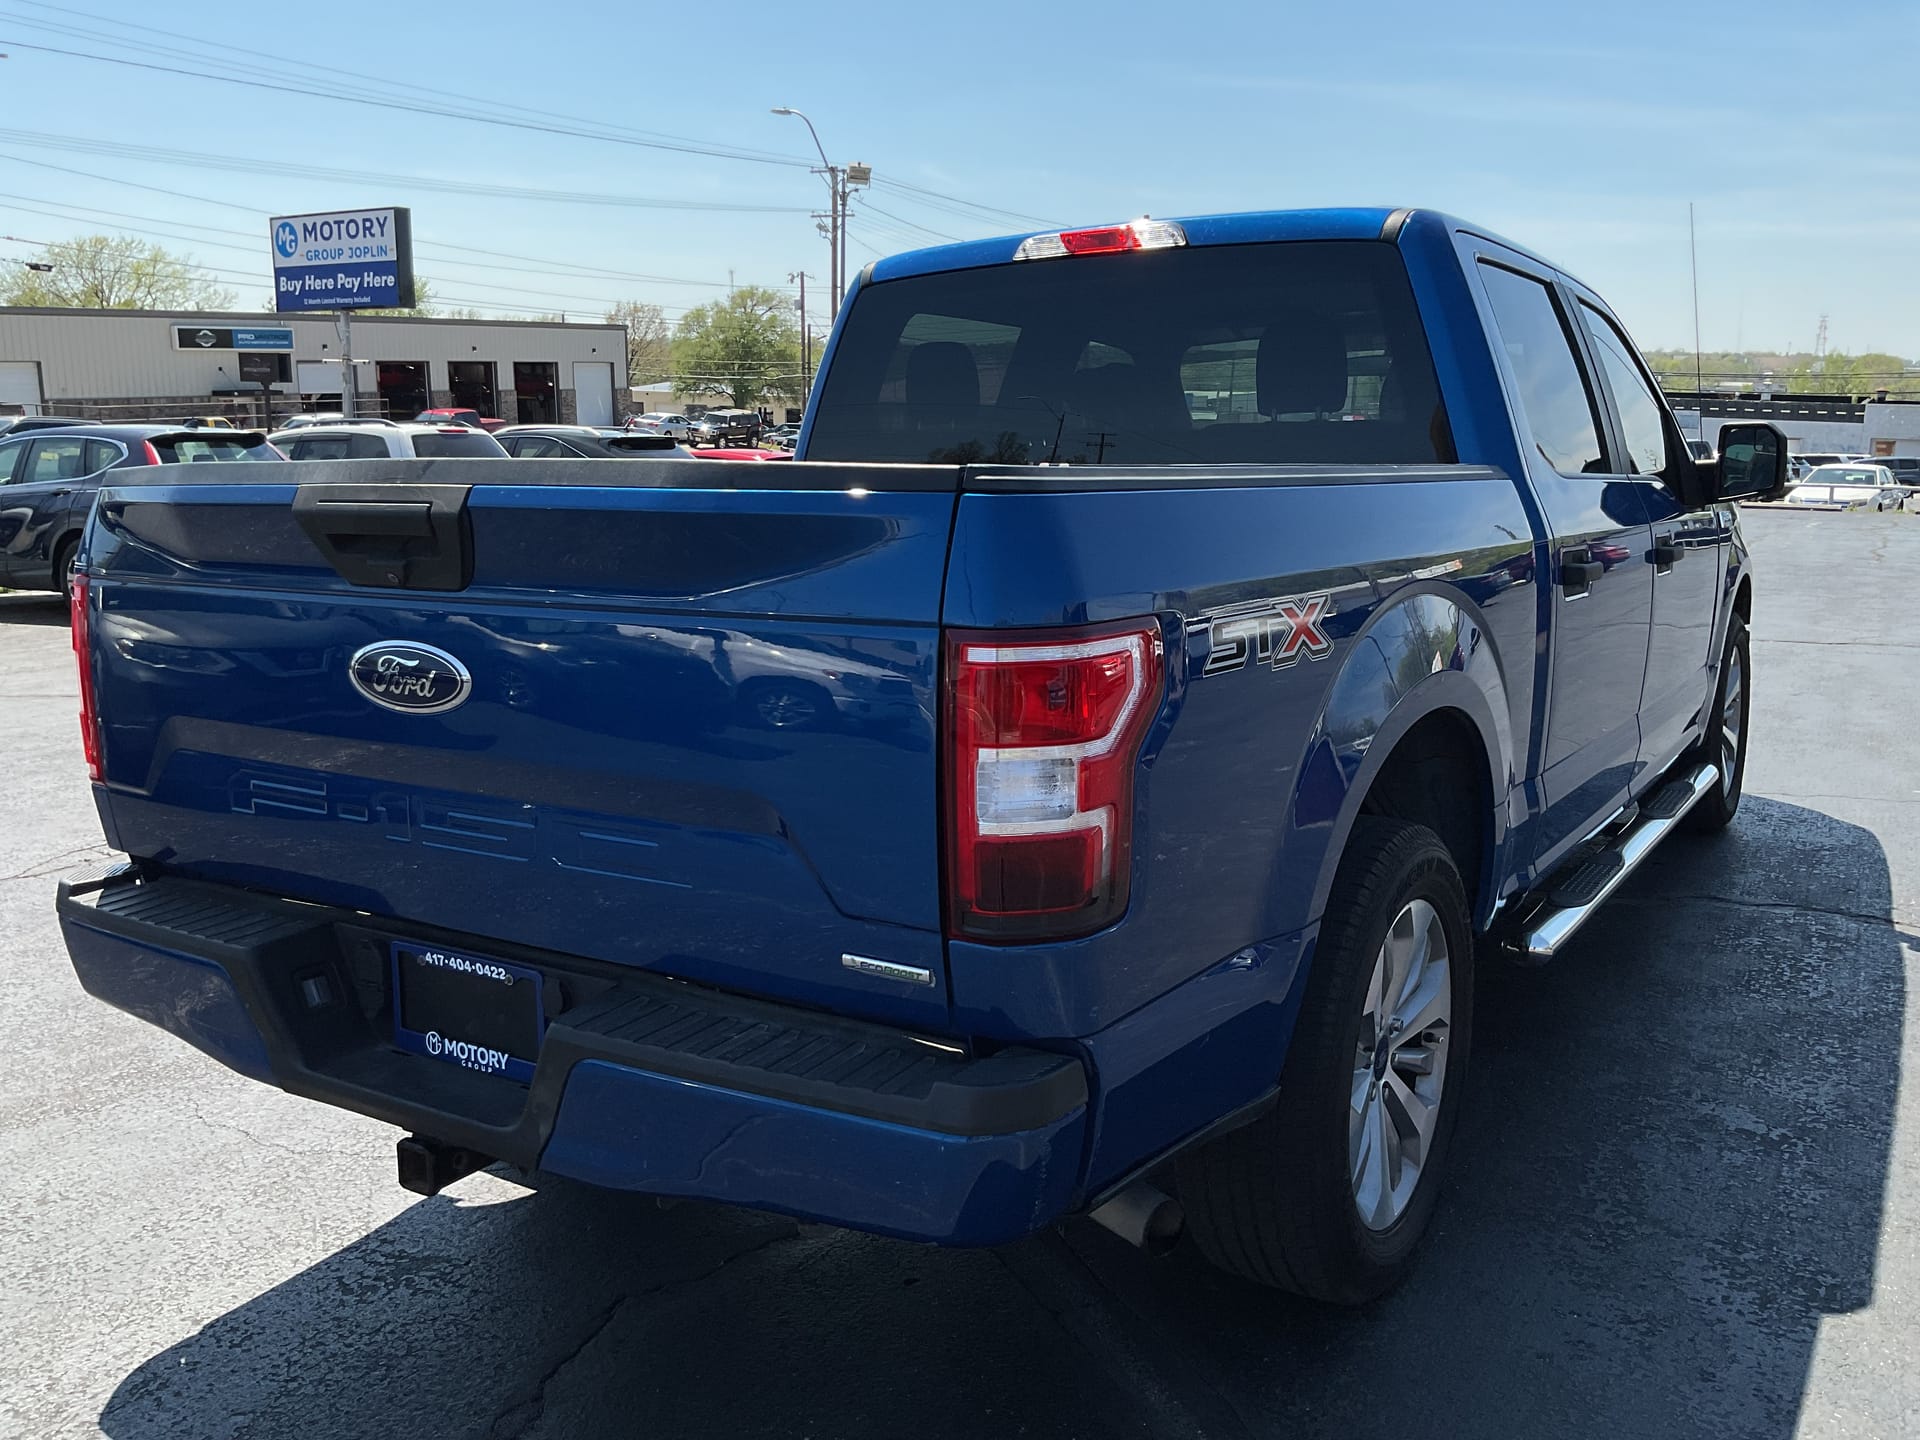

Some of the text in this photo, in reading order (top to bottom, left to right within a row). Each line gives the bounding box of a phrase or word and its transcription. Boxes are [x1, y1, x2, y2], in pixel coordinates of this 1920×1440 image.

[302, 216, 388, 243] MOTORY
[305, 244, 388, 261] GROUP JOPLIN
[279, 271, 395, 295] Buy Here Pay Here
[1203, 590, 1334, 678] STX
[373, 655, 436, 697] Ford
[444, 1038, 509, 1070] MOTORY
[461, 1060, 493, 1073] GROUP
